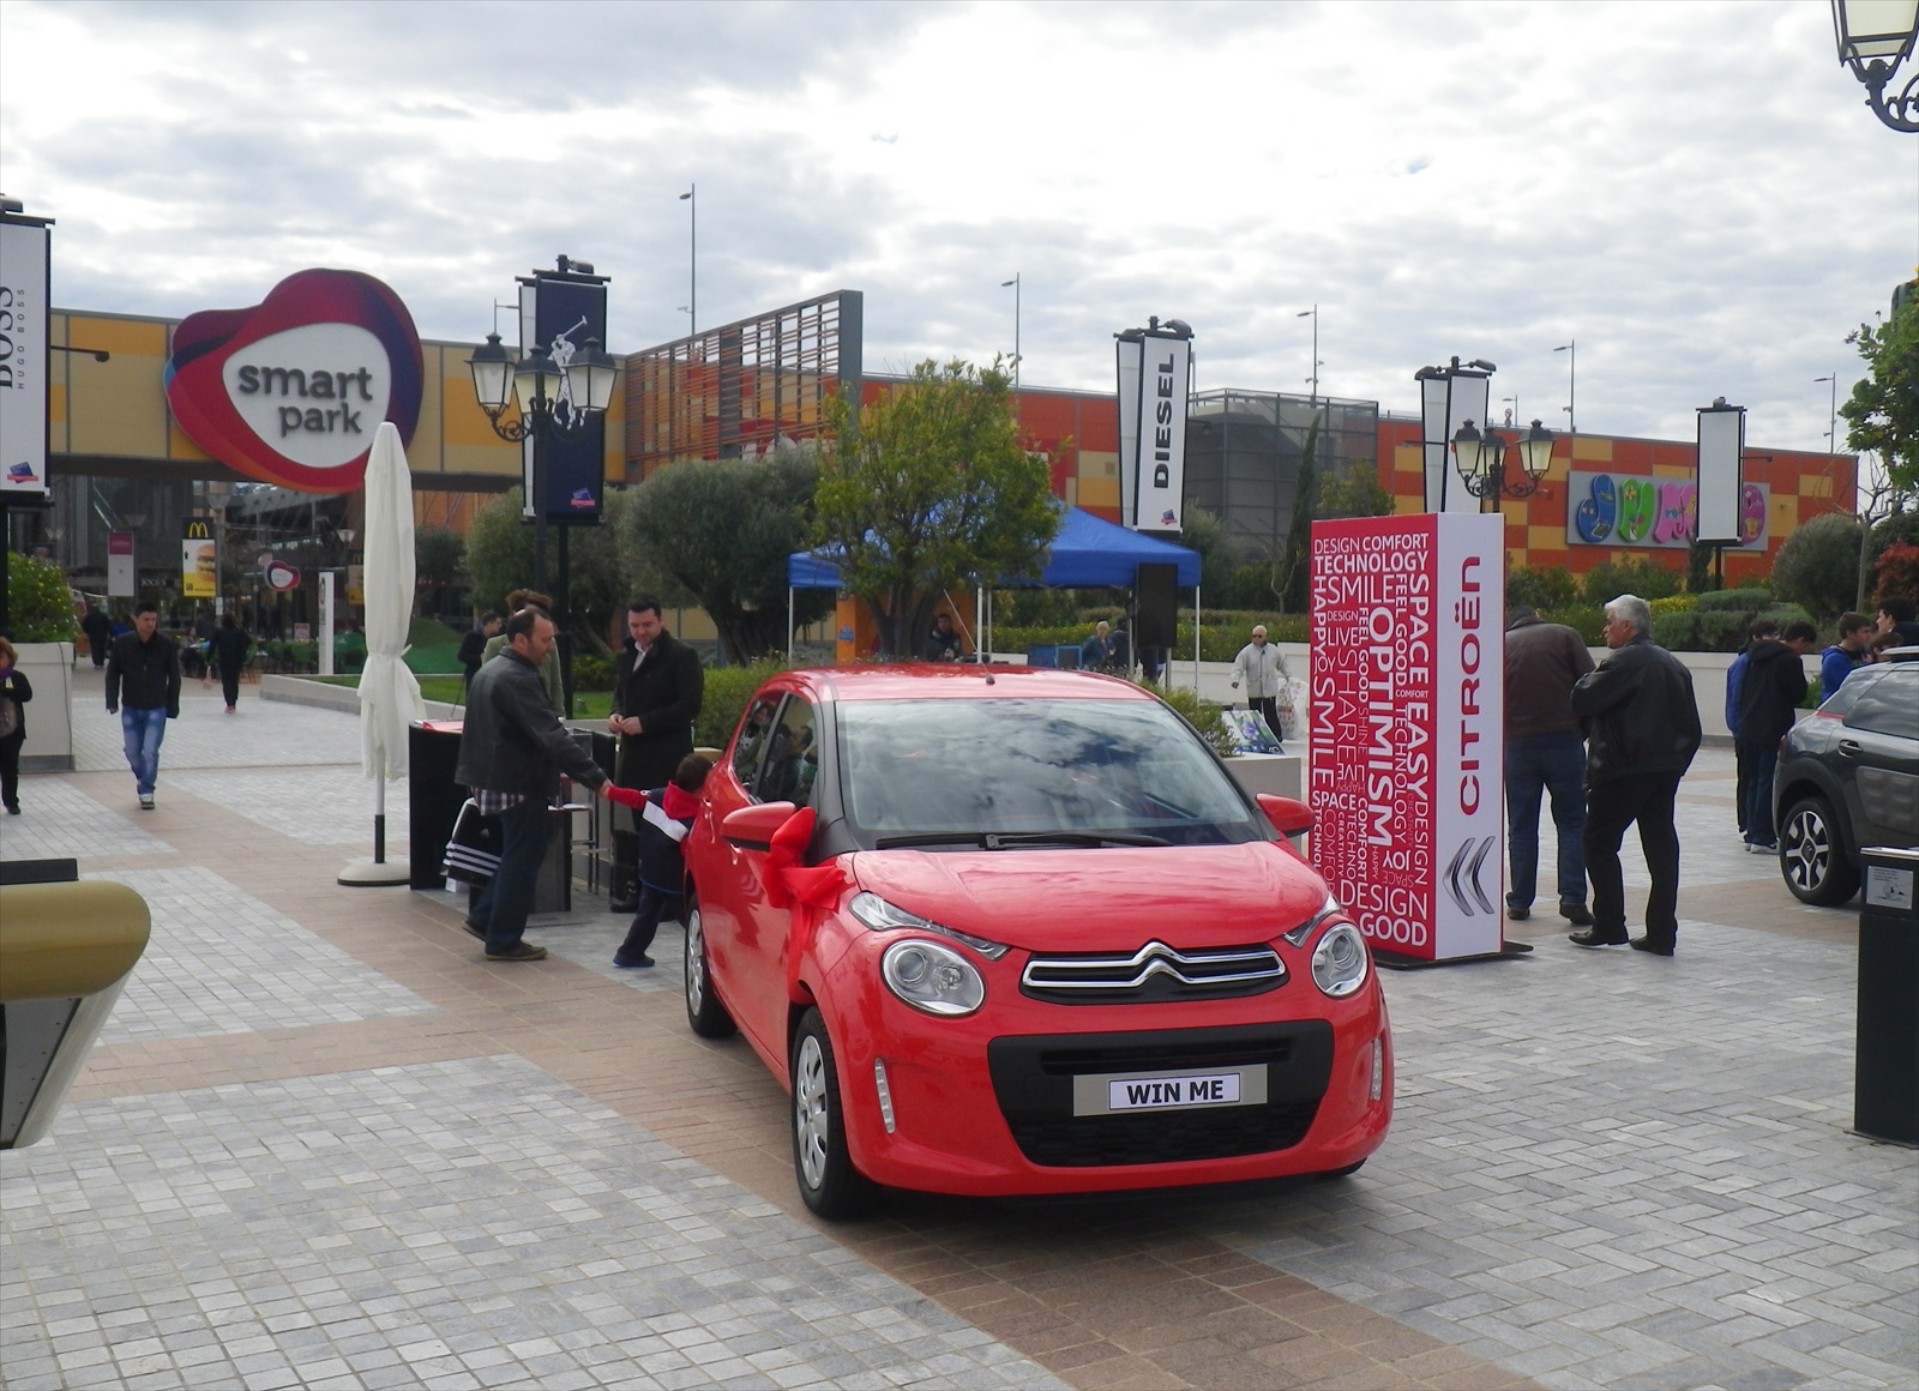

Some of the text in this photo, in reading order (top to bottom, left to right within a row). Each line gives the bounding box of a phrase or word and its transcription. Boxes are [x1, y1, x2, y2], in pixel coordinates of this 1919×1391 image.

[17, 289, 25, 389] HUGO BOSS
[238, 364, 373, 401] smart
[278, 402, 362, 438] park
[1154, 353, 1174, 489] DIESEL
[1314, 533, 1428, 554] DESIGN COMFORT
[1314, 551, 1428, 574] TECHNOLOGY
[1327, 574, 1395, 604] SMILE
[1314, 576, 1326, 656] HAPPY
[1327, 611, 1358, 621] DESIGN
[1328, 627, 1358, 646] LIVE
[1396, 573, 1407, 686] FEEL GOOD
[1409, 573, 1428, 684] SPACE
[1314, 656, 1335, 675] JOY
[1359, 608, 1368, 703] FEEL GOOD
[1337, 648, 1357, 762] SHARE
[1396, 690, 1428, 698] COMFORT
[1313, 676, 1335, 787] SMILE
[1358, 706, 1368, 755] SHINE
[1368, 607, 1394, 847] OPTIMISM
[1337, 763, 1364, 782] LIVE
[1407, 702, 1428, 800] EASY
[1395, 705, 1407, 844] TECHNOLOGY
[1312, 790, 1356, 811] SPACE
[1347, 813, 1357, 880] TECHNO
[1358, 798, 1367, 881] COMFORT
[1382, 850, 1411, 871] JOY
[1415, 801, 1428, 885] DESIGN
[1340, 879, 1427, 920] DESIGN
[1360, 912, 1427, 946] GOOD
[1127, 1079, 1223, 1105] WIN ME
